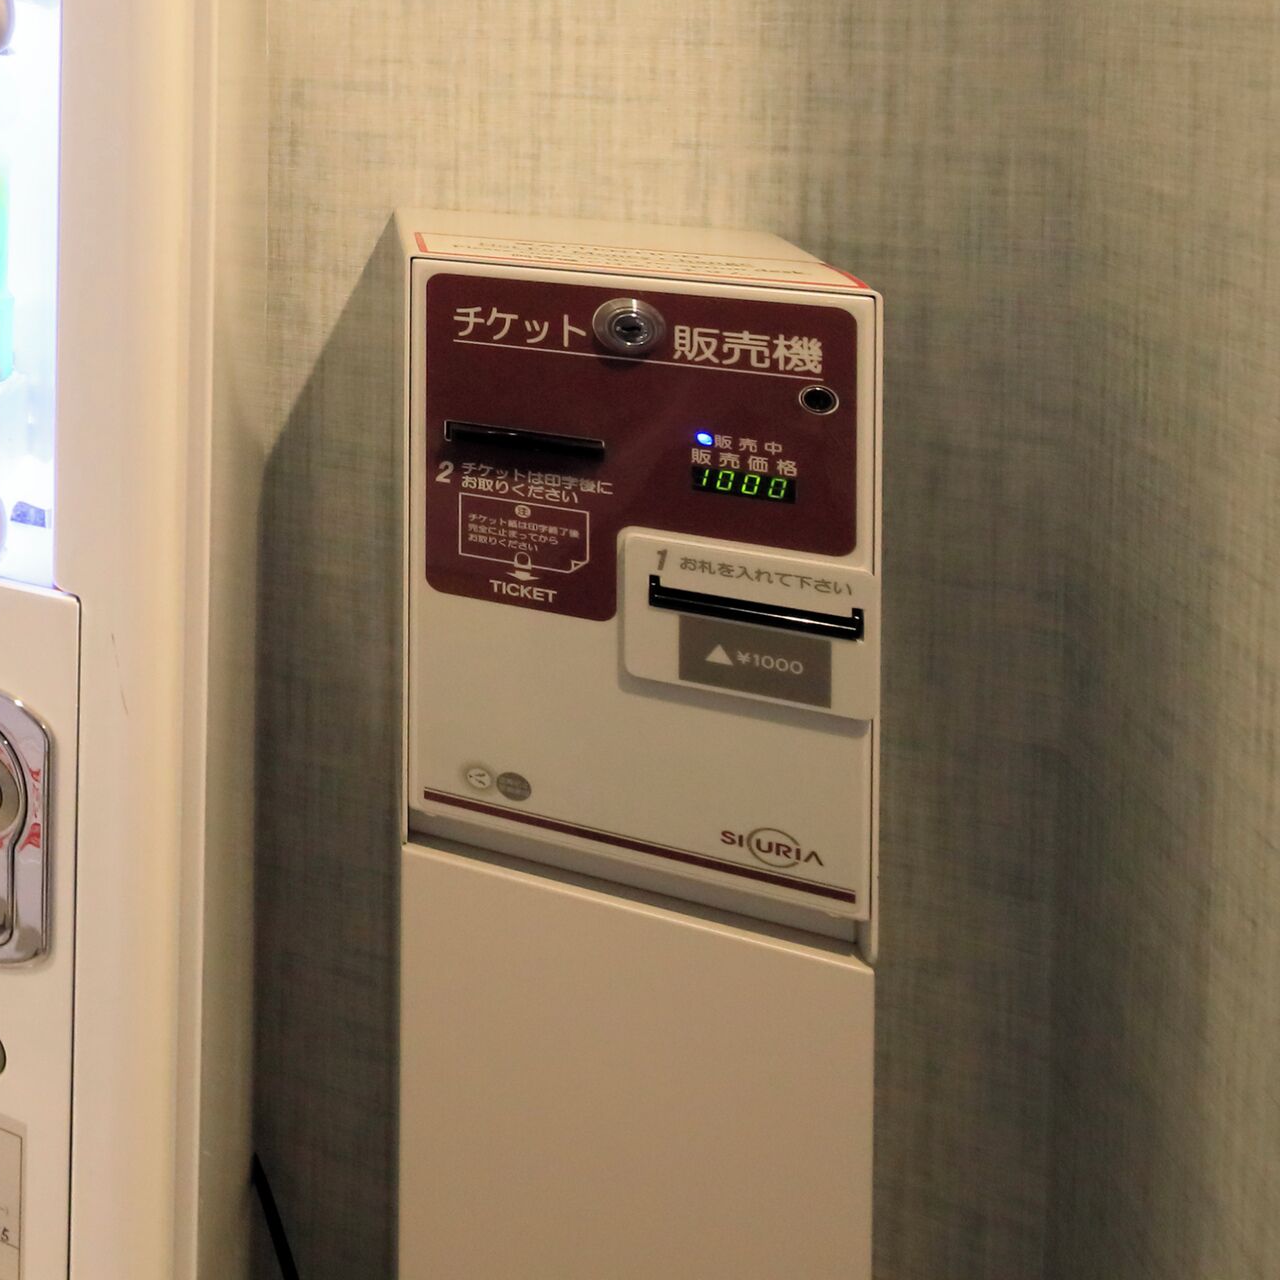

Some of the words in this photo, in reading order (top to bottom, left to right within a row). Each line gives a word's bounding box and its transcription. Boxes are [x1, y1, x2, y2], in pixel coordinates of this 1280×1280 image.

[452, 305, 587, 348] チケット
[672, 324, 824, 376] 販売機
[435, 461, 455, 484] 2
[700, 470, 786, 500] 1000
[679, 554, 853, 597] お札を入れて下さい
[488, 578, 558, 604] TICKET
[736, 650, 804, 675] ¥1000
